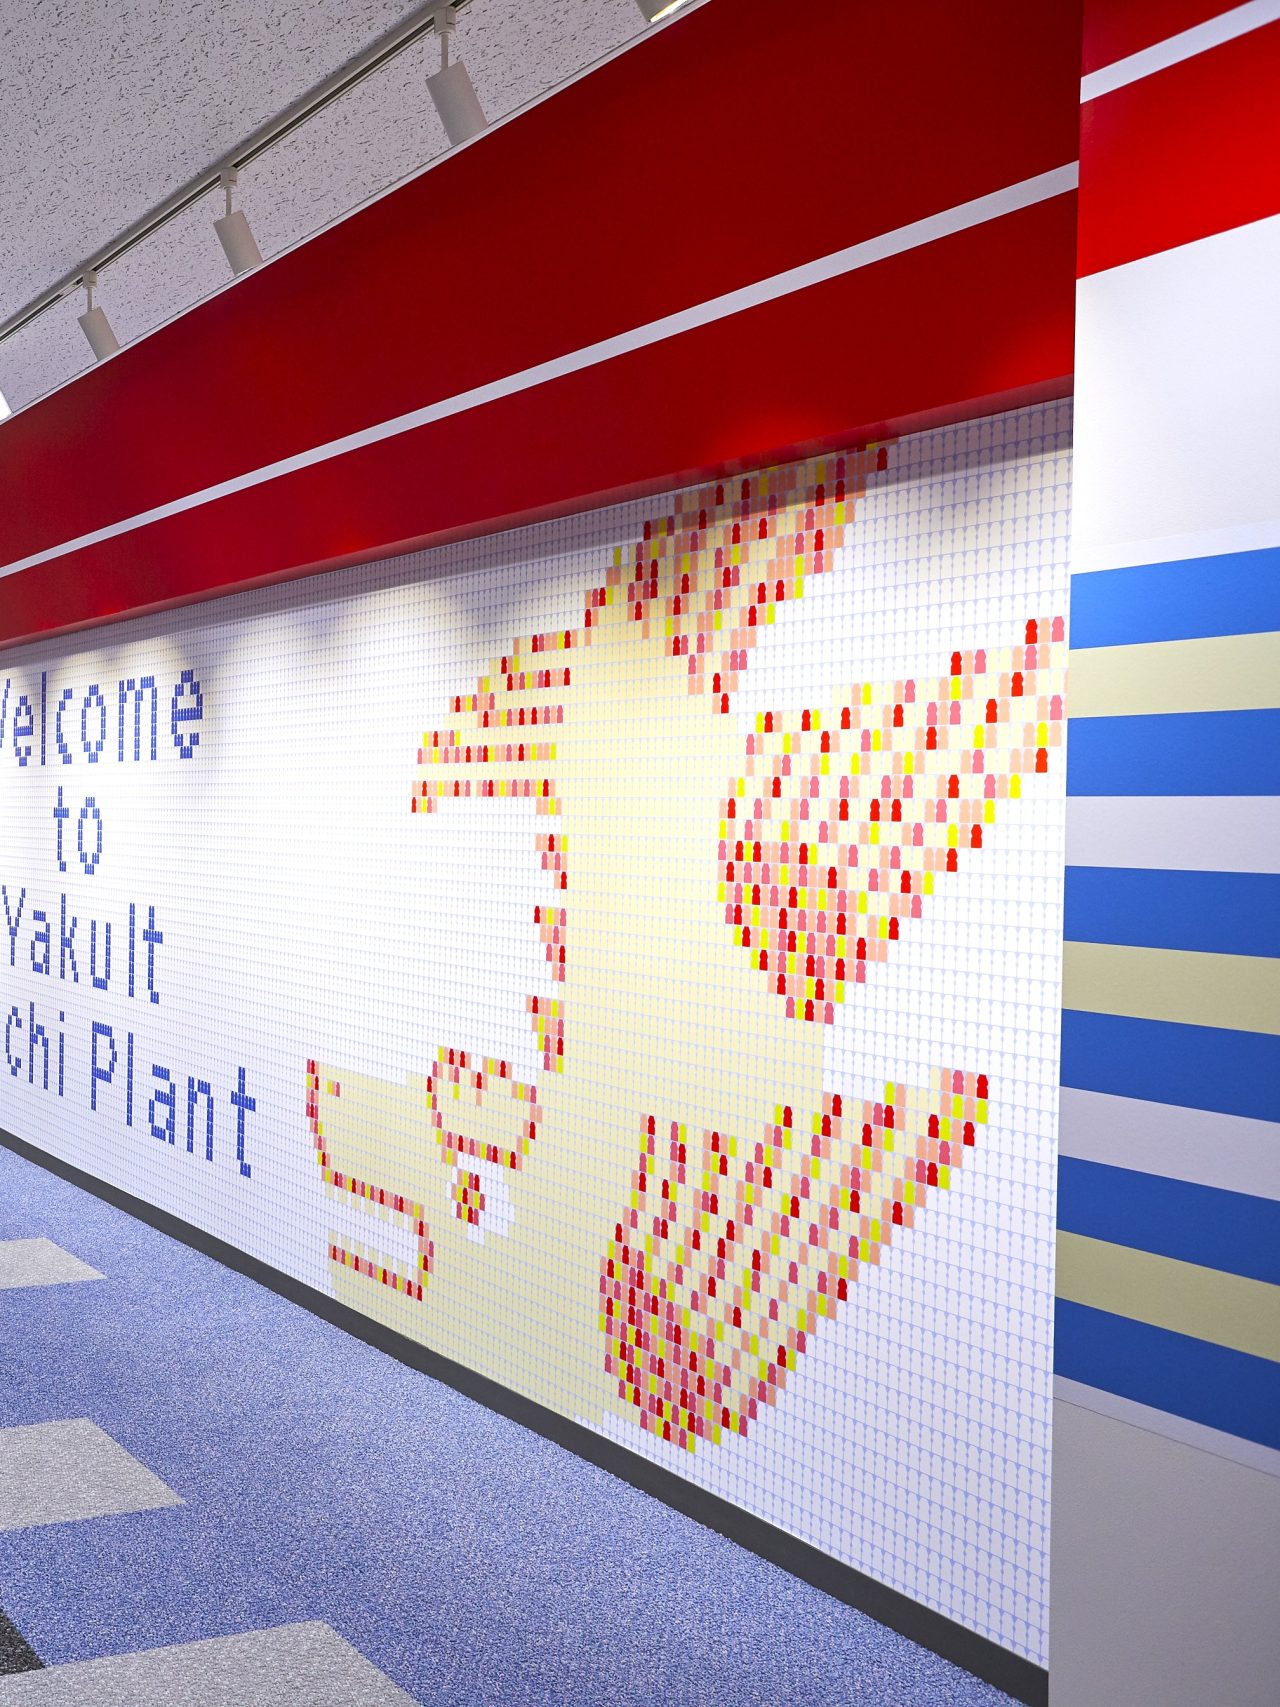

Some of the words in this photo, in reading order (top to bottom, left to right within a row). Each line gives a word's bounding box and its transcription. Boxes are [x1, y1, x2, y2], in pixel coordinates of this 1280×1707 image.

[53, 785, 103, 875] to
[1, 884, 163, 1004] Yakult
[90, 1020, 257, 1178] Plant
